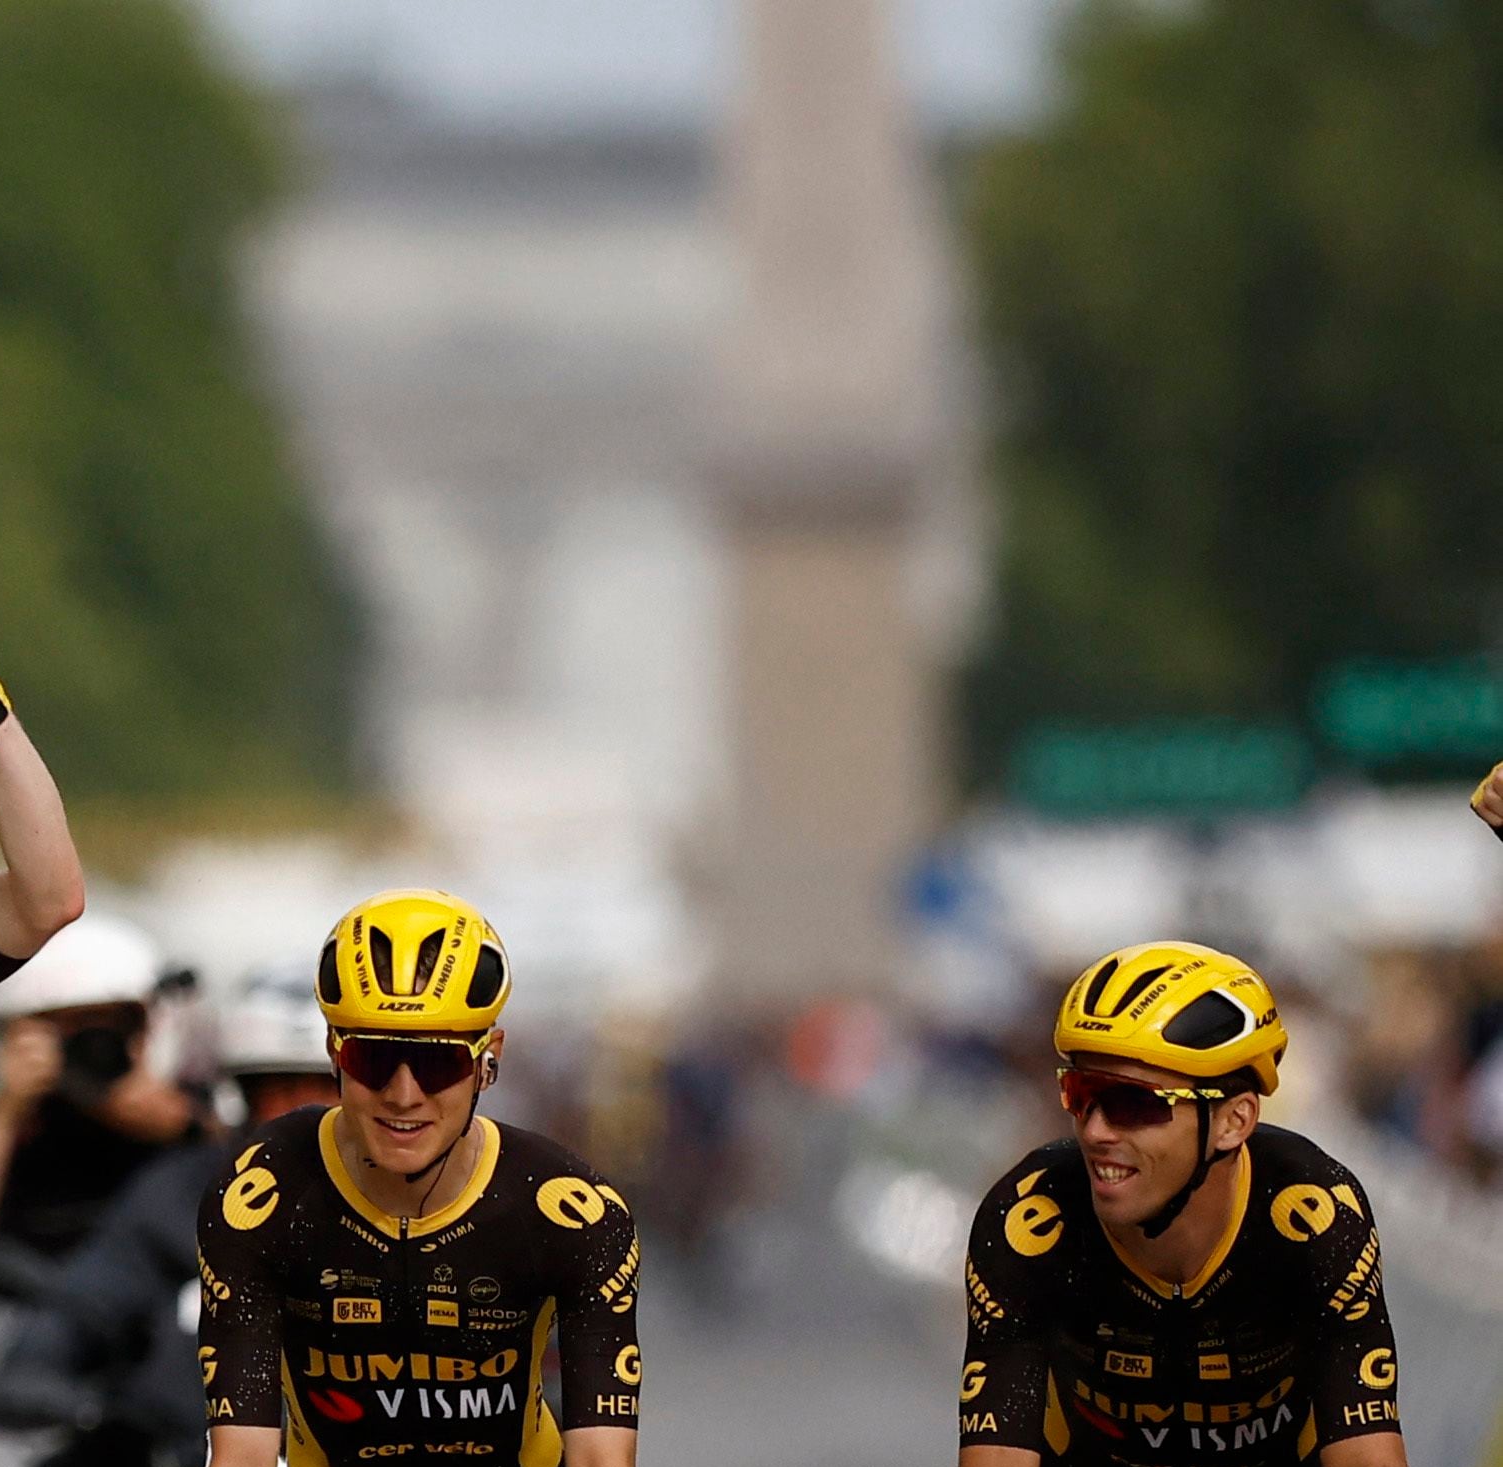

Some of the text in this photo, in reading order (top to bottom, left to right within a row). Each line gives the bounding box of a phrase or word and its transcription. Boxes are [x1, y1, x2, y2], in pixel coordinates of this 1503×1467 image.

[432, 953, 456, 1000] JUMBO
[1128, 959, 1209, 1020] JUMBO VISMA
[377, 1001, 426, 1012] LAZER
[1074, 1019, 1114, 1032] LAZER
[339, 1215, 475, 1253] JUMBO VISMA
[427, 1284, 458, 1294] AGU
[1329, 1227, 1380, 1314] JUMBO
[352, 1302, 373, 1311] BET
[352, 1310, 378, 1320] CITY
[428, 1308, 457, 1318] HEMA
[303, 1347, 518, 1382] JUMBO
[615, 1344, 642, 1386] G
[1359, 1347, 1397, 1390] G
[375, 1382, 516, 1419] VISMA
[1072, 1375, 1295, 1424] JUMBO
[1140, 1402, 1294, 1452] VISMA
